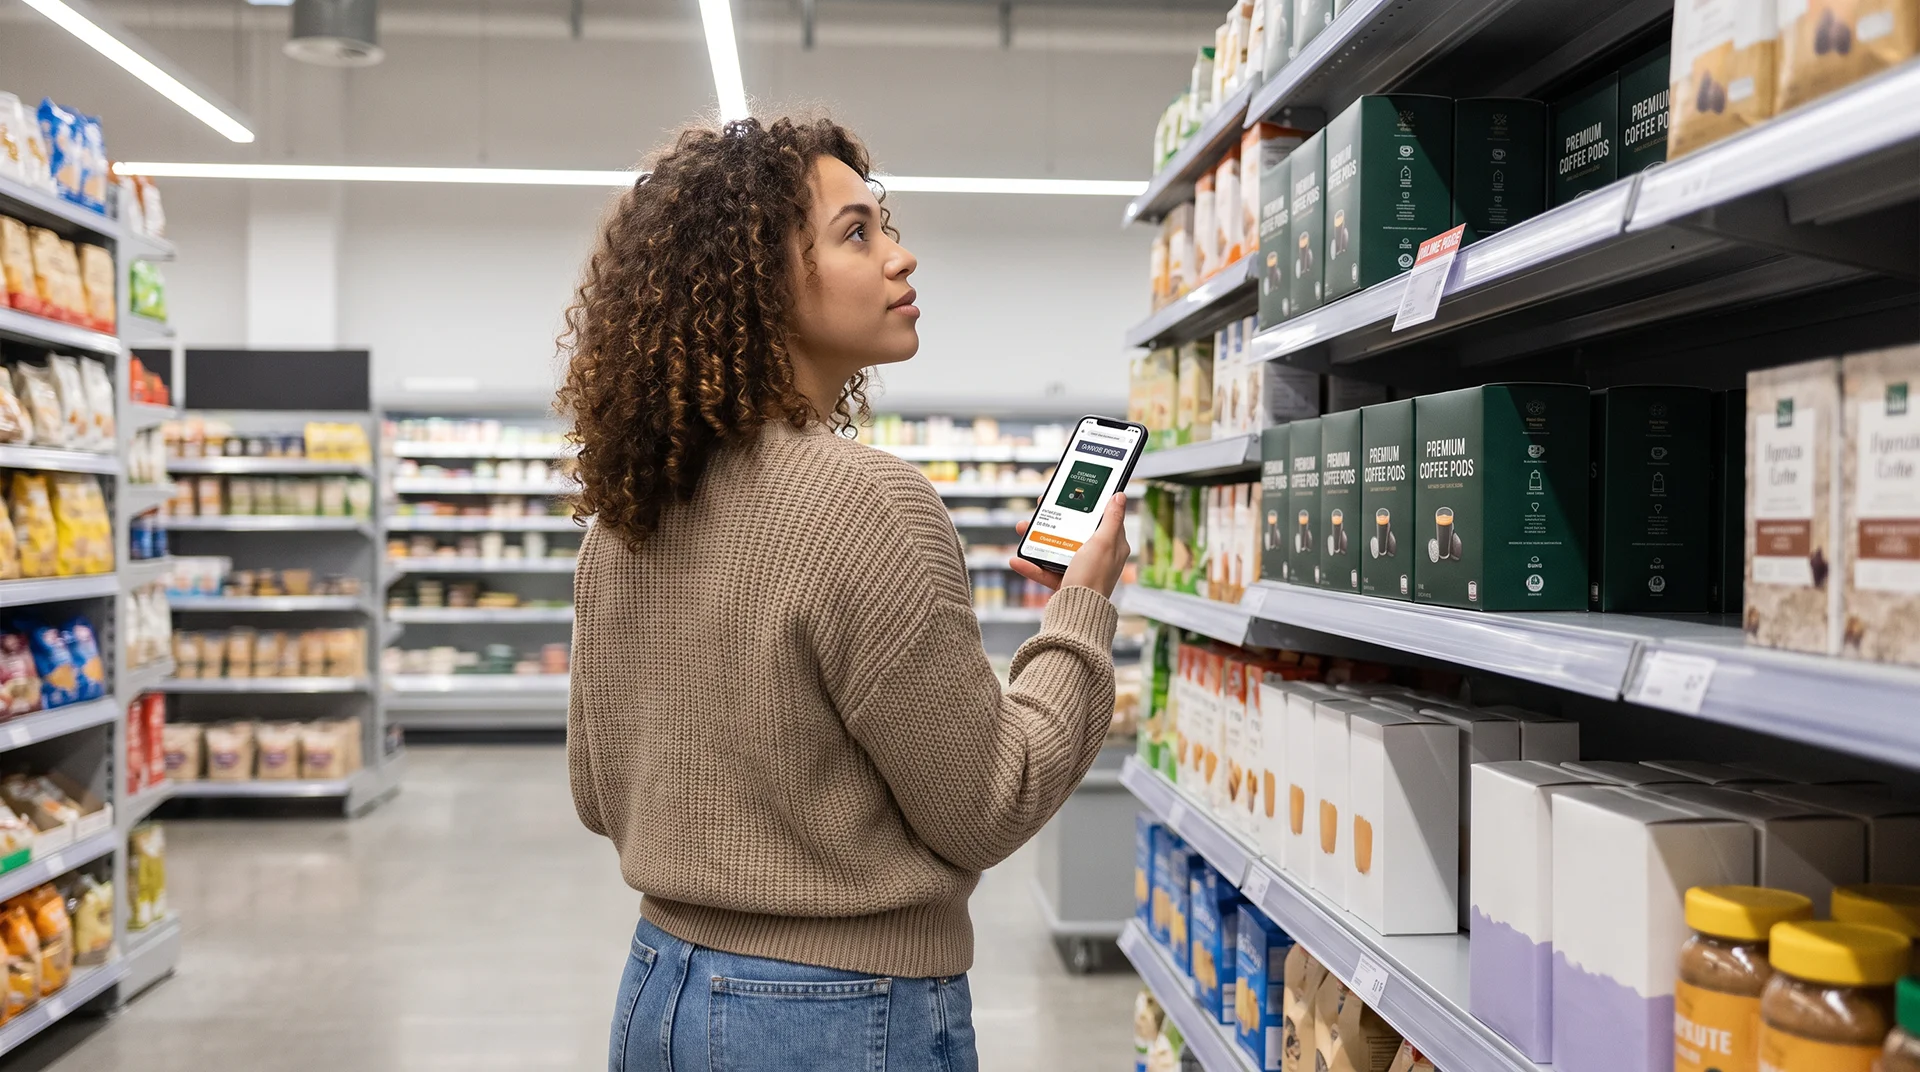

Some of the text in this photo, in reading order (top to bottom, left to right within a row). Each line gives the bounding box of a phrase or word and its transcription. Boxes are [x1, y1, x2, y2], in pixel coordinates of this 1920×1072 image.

[1565, 121, 1602, 154] PREMIUM
[1624, 110, 1669, 147] COFFEE PO
[1559, 149, 1587, 175] COFFEE
[1587, 139, 1609, 163] PODS
[1369, 445, 1400, 464] PREMIUM
[1426, 437, 1466, 458] PREMIUM
[1364, 464, 1406, 483] COFFEE PODS
[1419, 458, 1474, 480] COFFEE PODS
